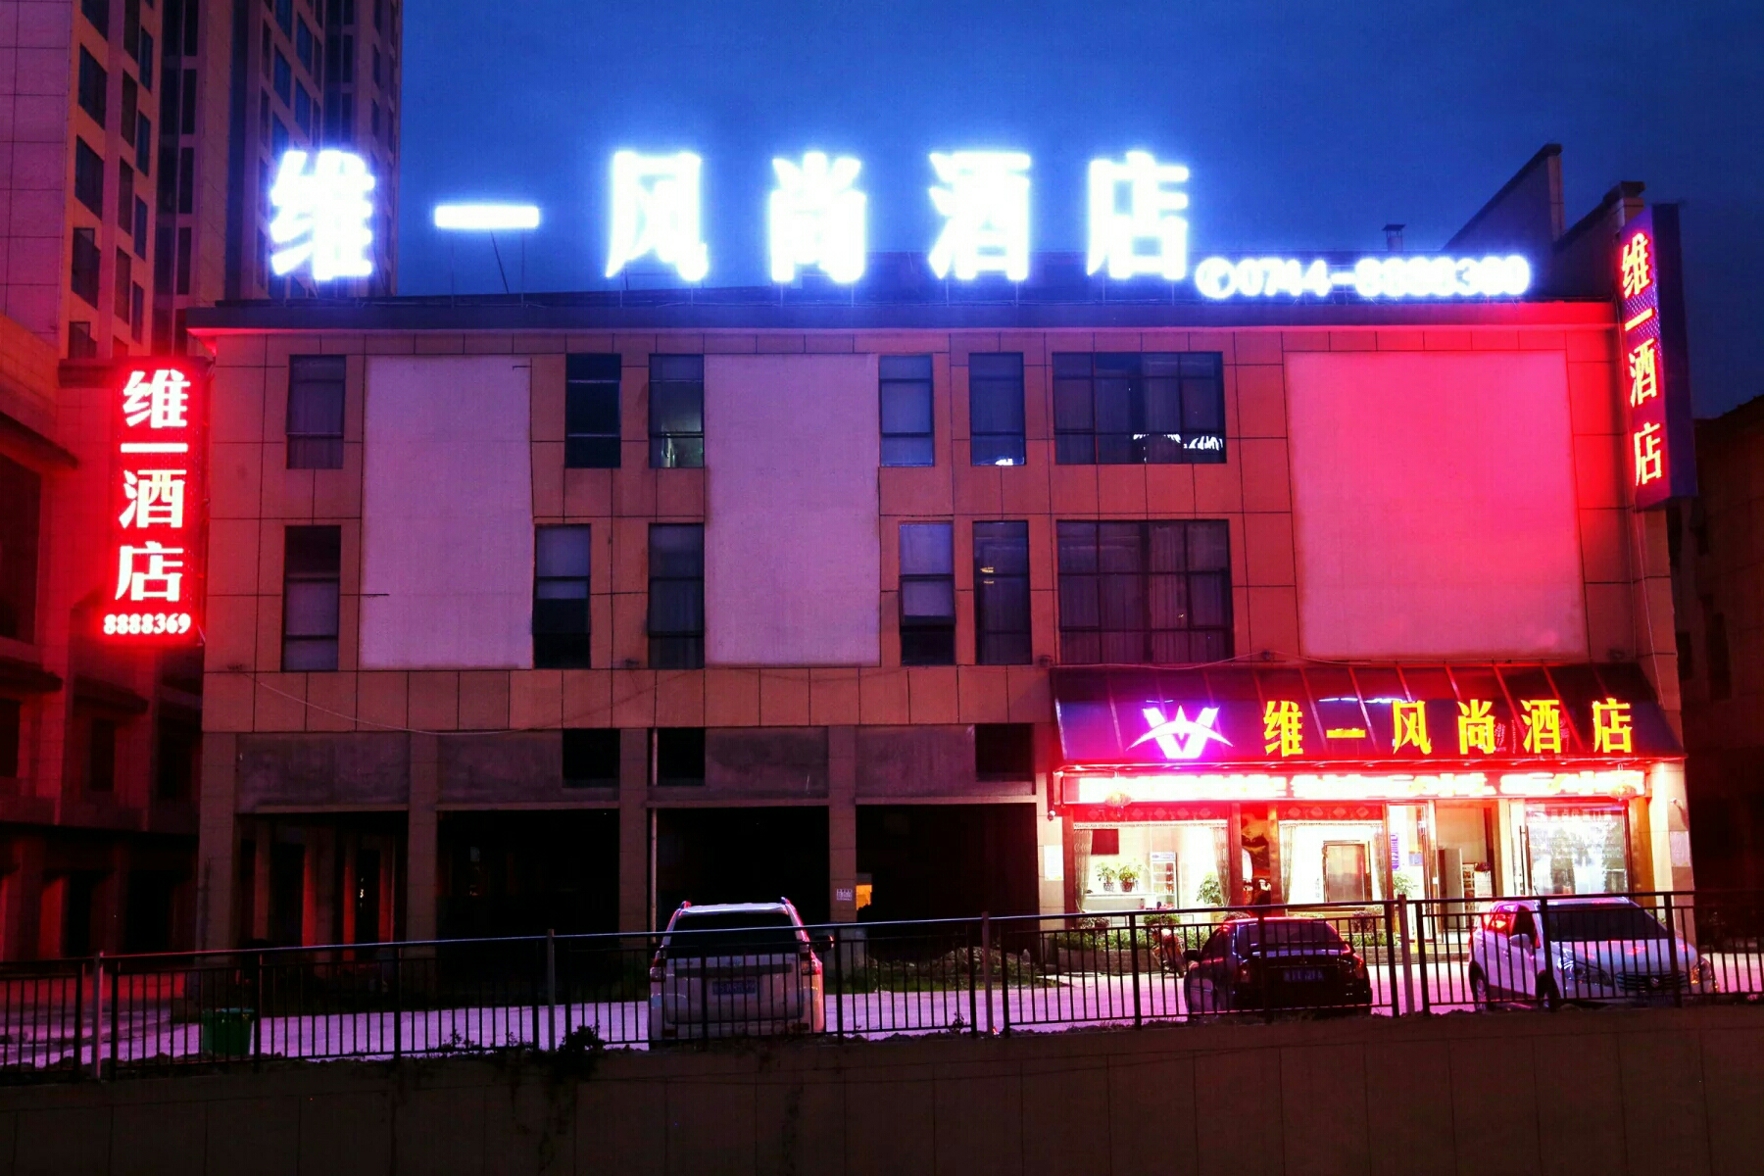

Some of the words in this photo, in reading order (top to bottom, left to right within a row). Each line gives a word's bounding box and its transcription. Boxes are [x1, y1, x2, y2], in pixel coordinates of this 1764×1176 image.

[270, 150, 1189, 283] 维一风尚酒店
[1621, 233, 1663, 485] 维一酒店
[115, 369, 190, 601] 维一酒店
[103, 612, 191, 635] 8888369
[1263, 698, 1632, 757] 维一风尚酒店
